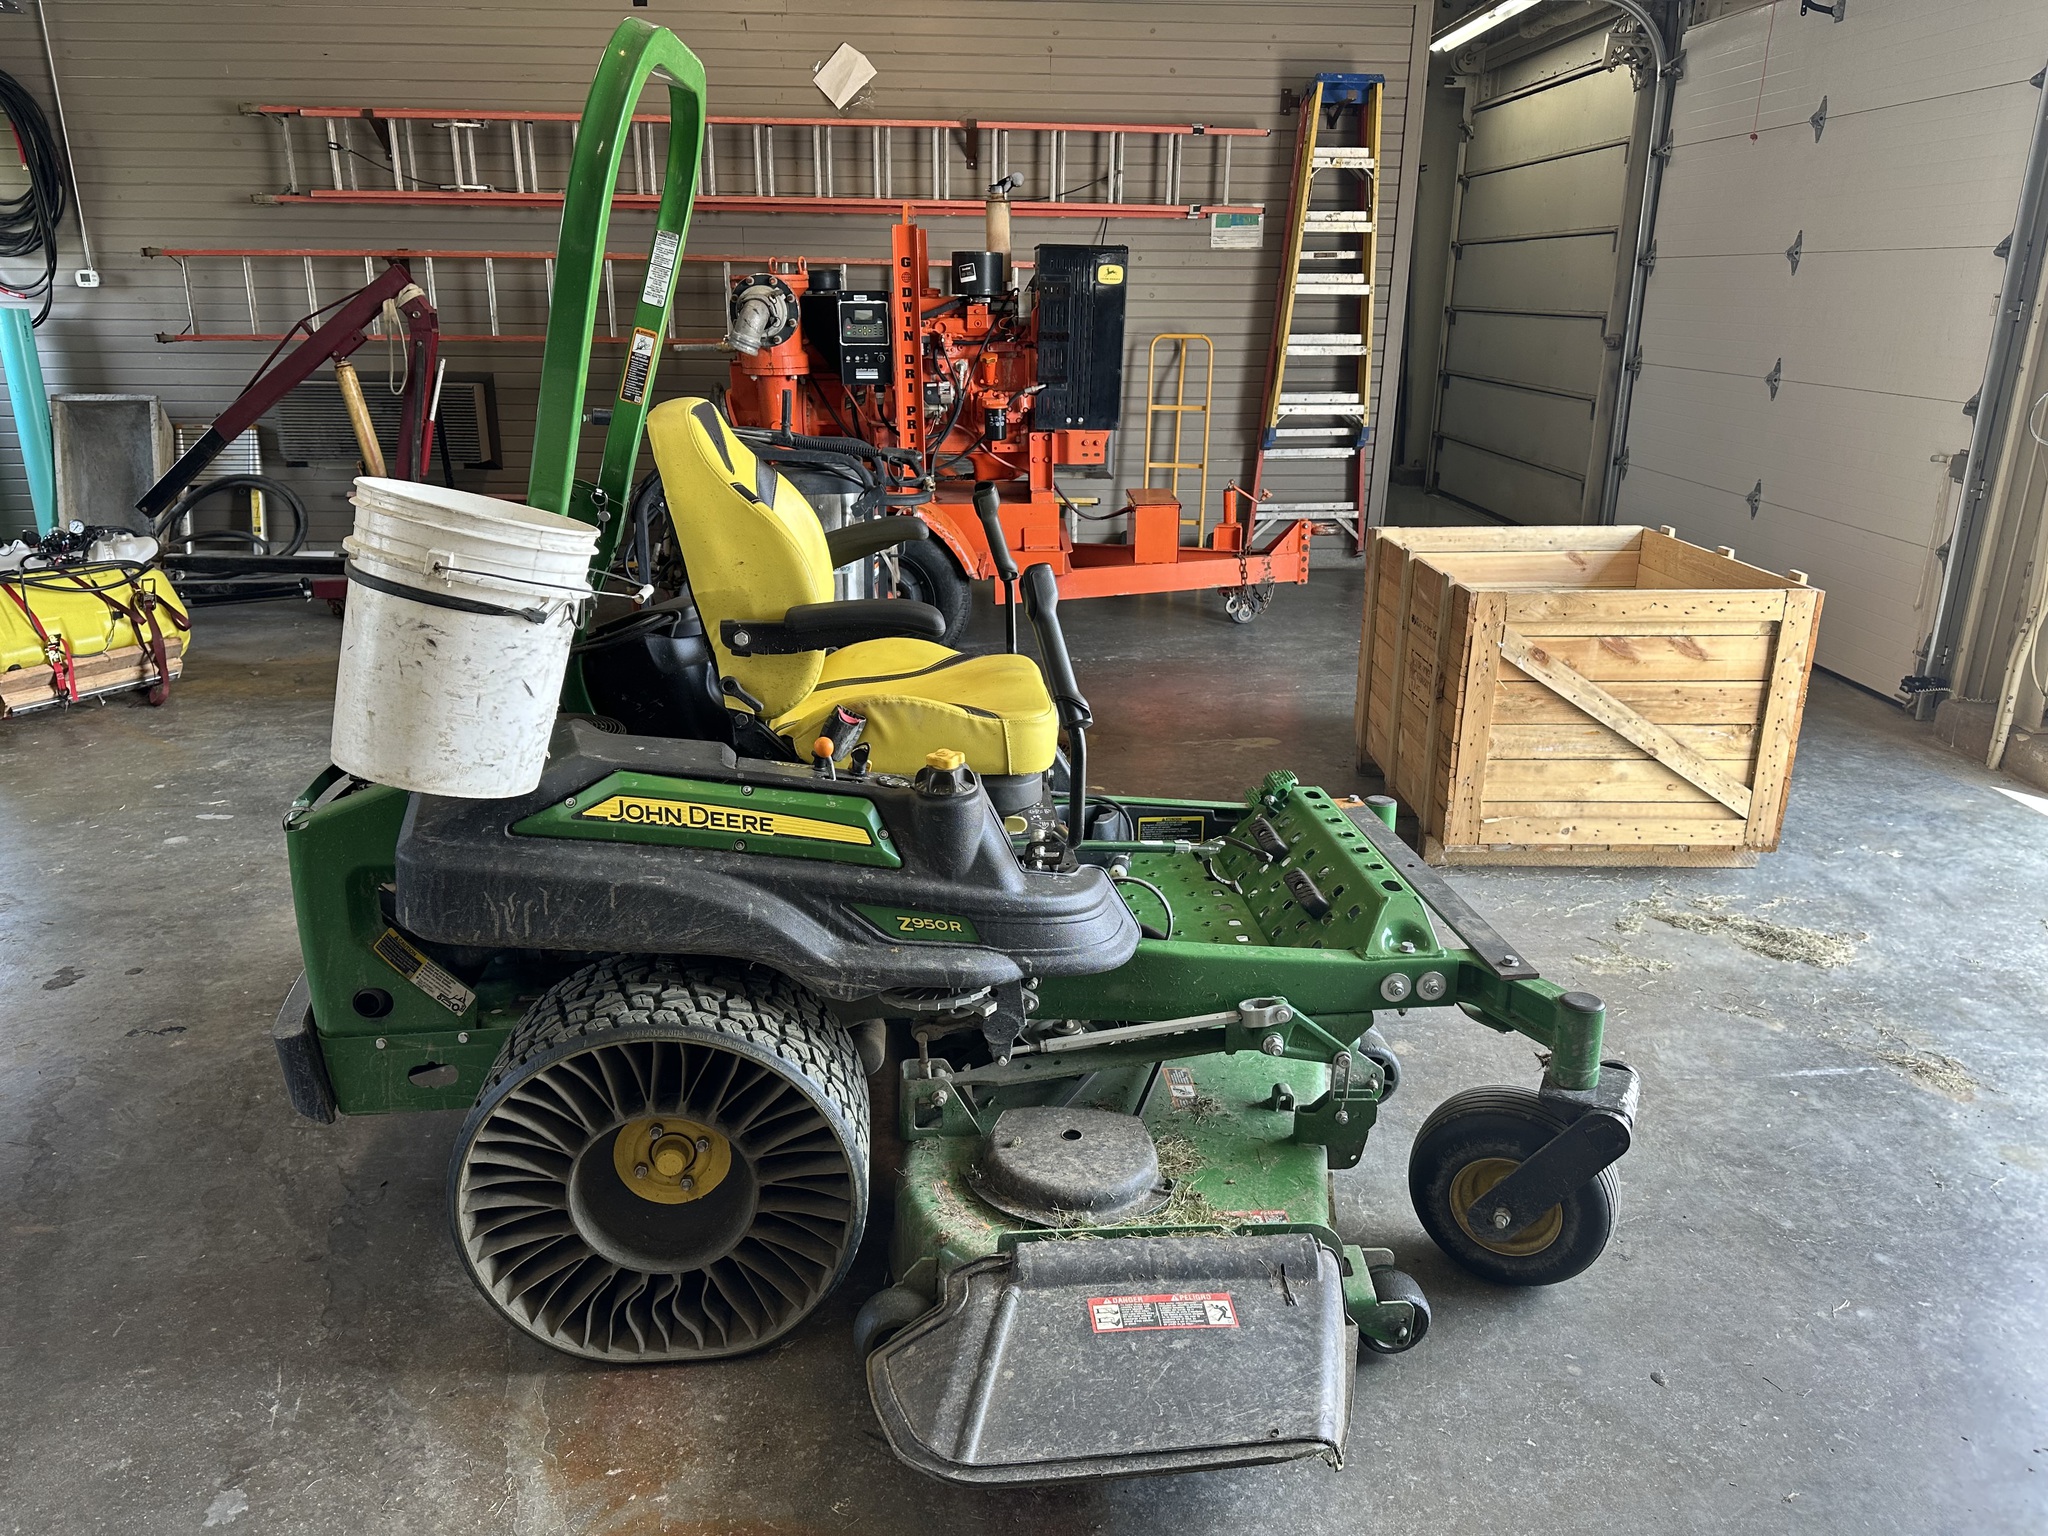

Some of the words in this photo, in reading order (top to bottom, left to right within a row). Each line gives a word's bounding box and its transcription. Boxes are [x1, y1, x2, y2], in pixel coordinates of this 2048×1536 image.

[904, 354, 916, 393] DRI
[906, 406, 918, 450] PRI
[610, 799, 682, 824] JOHN
[688, 806, 774, 832] DEERE
[896, 916, 963, 933] Z950R
[398, 938, 418, 957] CAUTION
[1112, 1296, 1144, 1304] DANGER
[1179, 1293, 1212, 1301] PELIGRO
